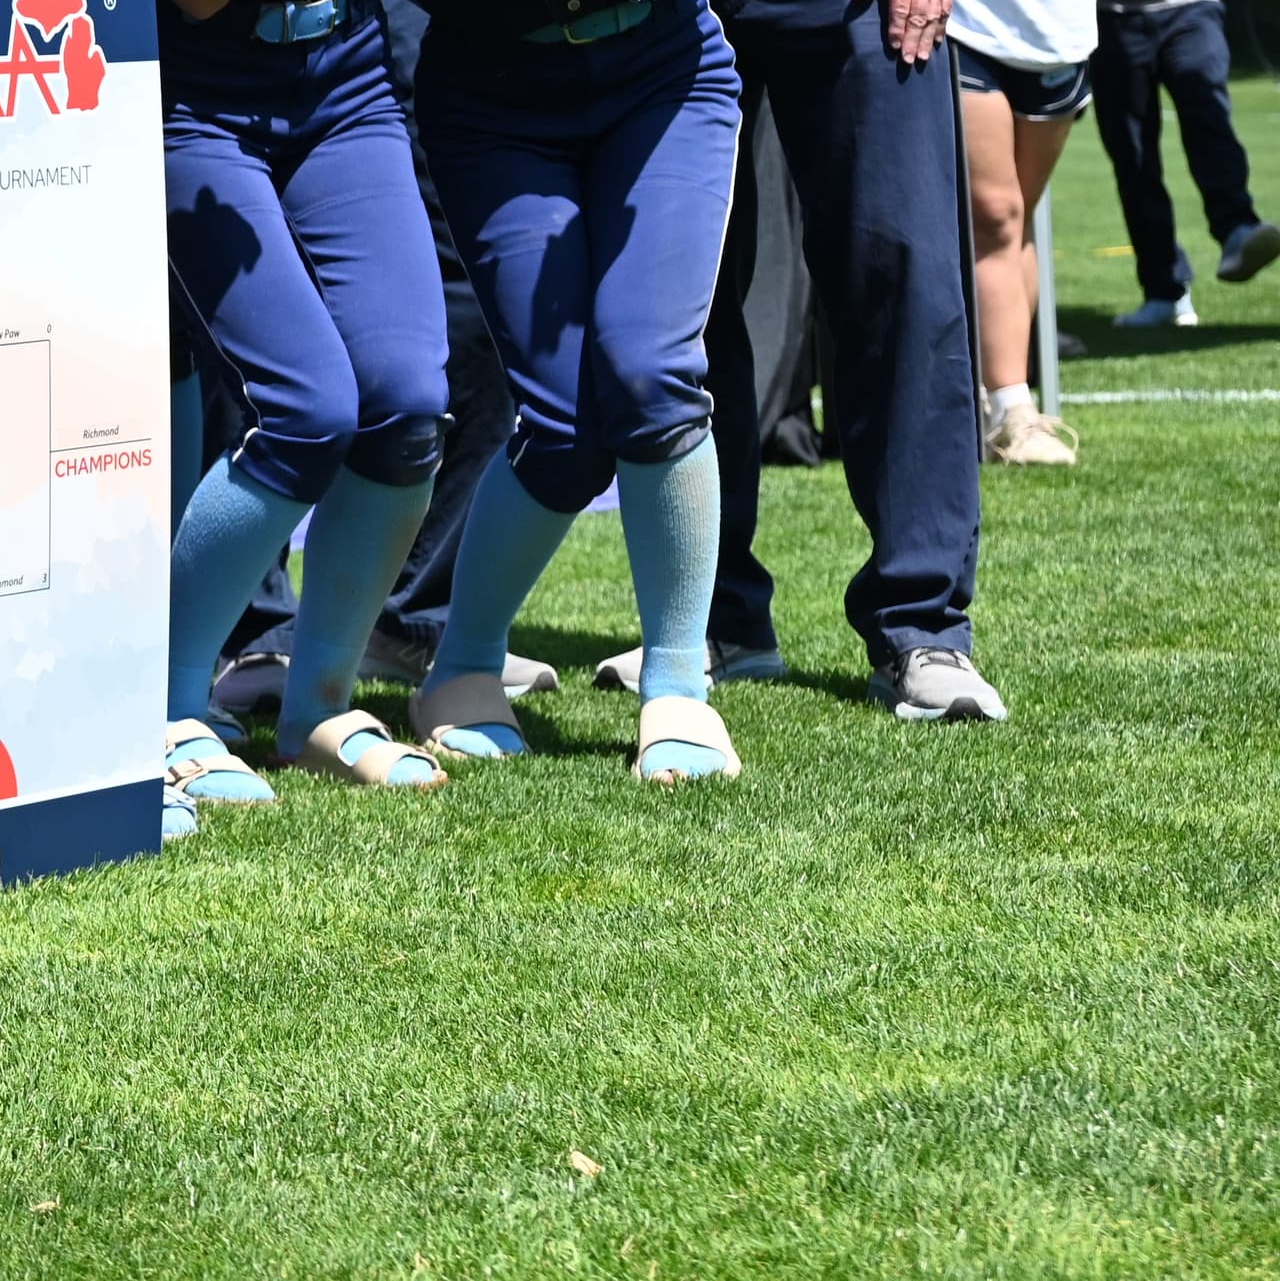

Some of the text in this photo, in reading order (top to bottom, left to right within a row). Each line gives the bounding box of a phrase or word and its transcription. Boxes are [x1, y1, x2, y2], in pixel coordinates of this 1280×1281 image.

[3, 328, 20, 340] Paw
[46, 323, 52, 334] 0
[82, 425, 120, 439] Richmond
[54, 448, 153, 479] CHAMPIONS
[42, 573, 48, 584] 3
